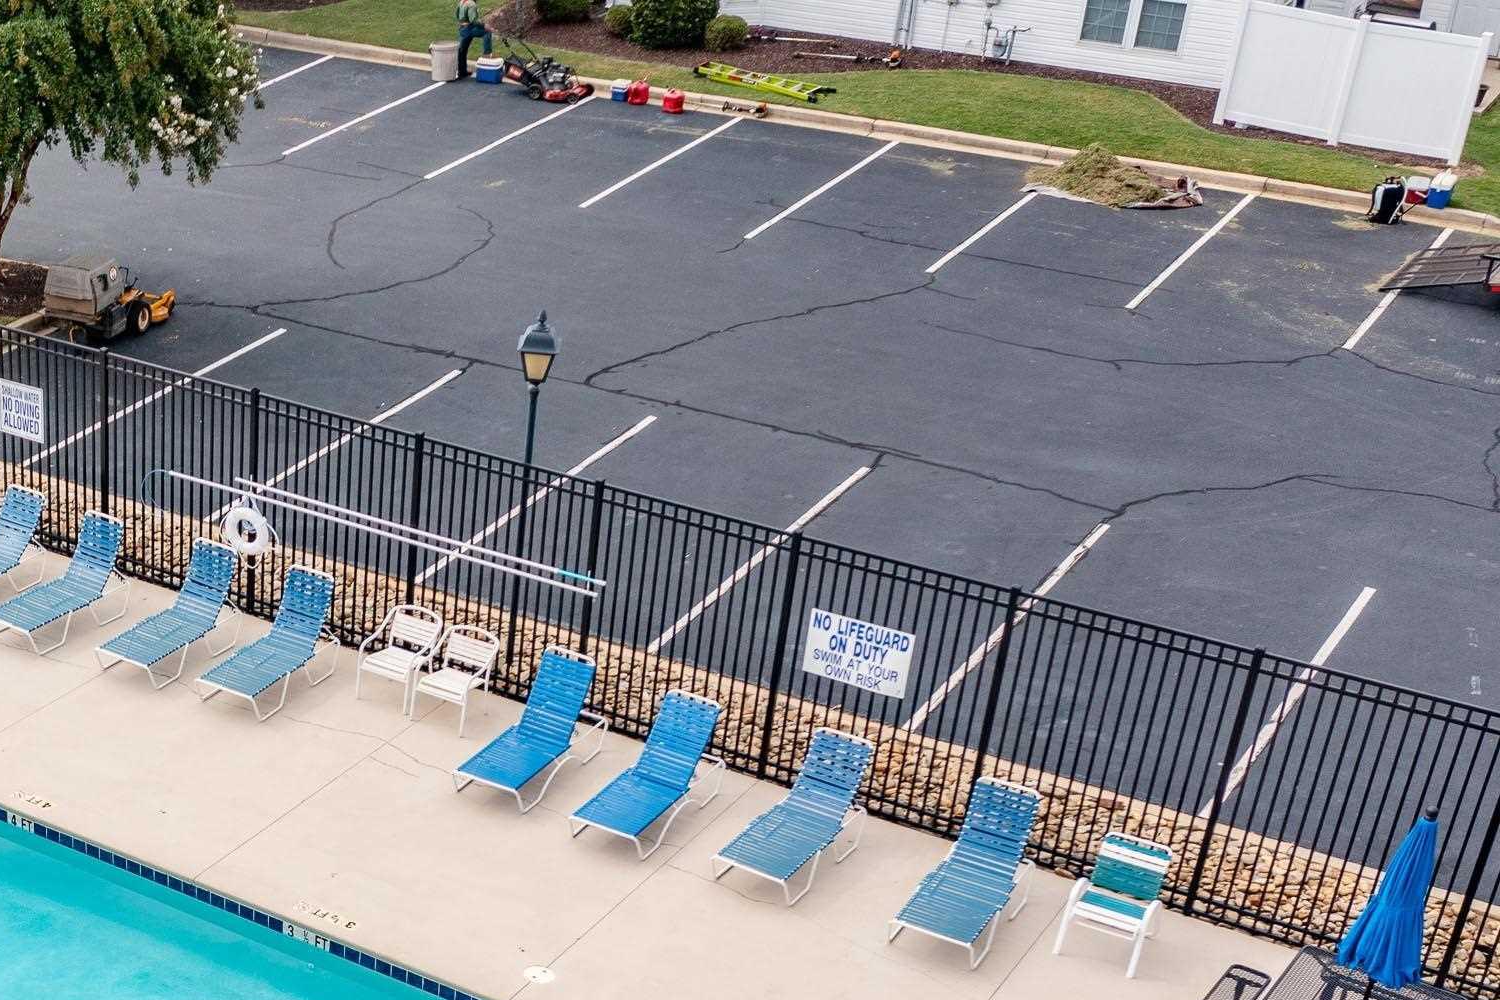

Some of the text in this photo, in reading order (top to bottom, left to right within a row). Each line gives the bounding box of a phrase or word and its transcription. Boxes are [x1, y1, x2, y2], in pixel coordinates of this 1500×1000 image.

[3, 396, 40, 420] NO DIVING
[4, 412, 40, 435] ALLOWED
[813, 612, 910, 652] NO LIFEGUARD
[829, 635, 888, 664] ON DUTY
[813, 648, 899, 681] SWIM AT YOUR
[824, 664, 881, 690] OWN RISK
[21, 818, 33, 832] FT
[287, 924, 294, 937] 3
[315, 935, 328, 950] FT
